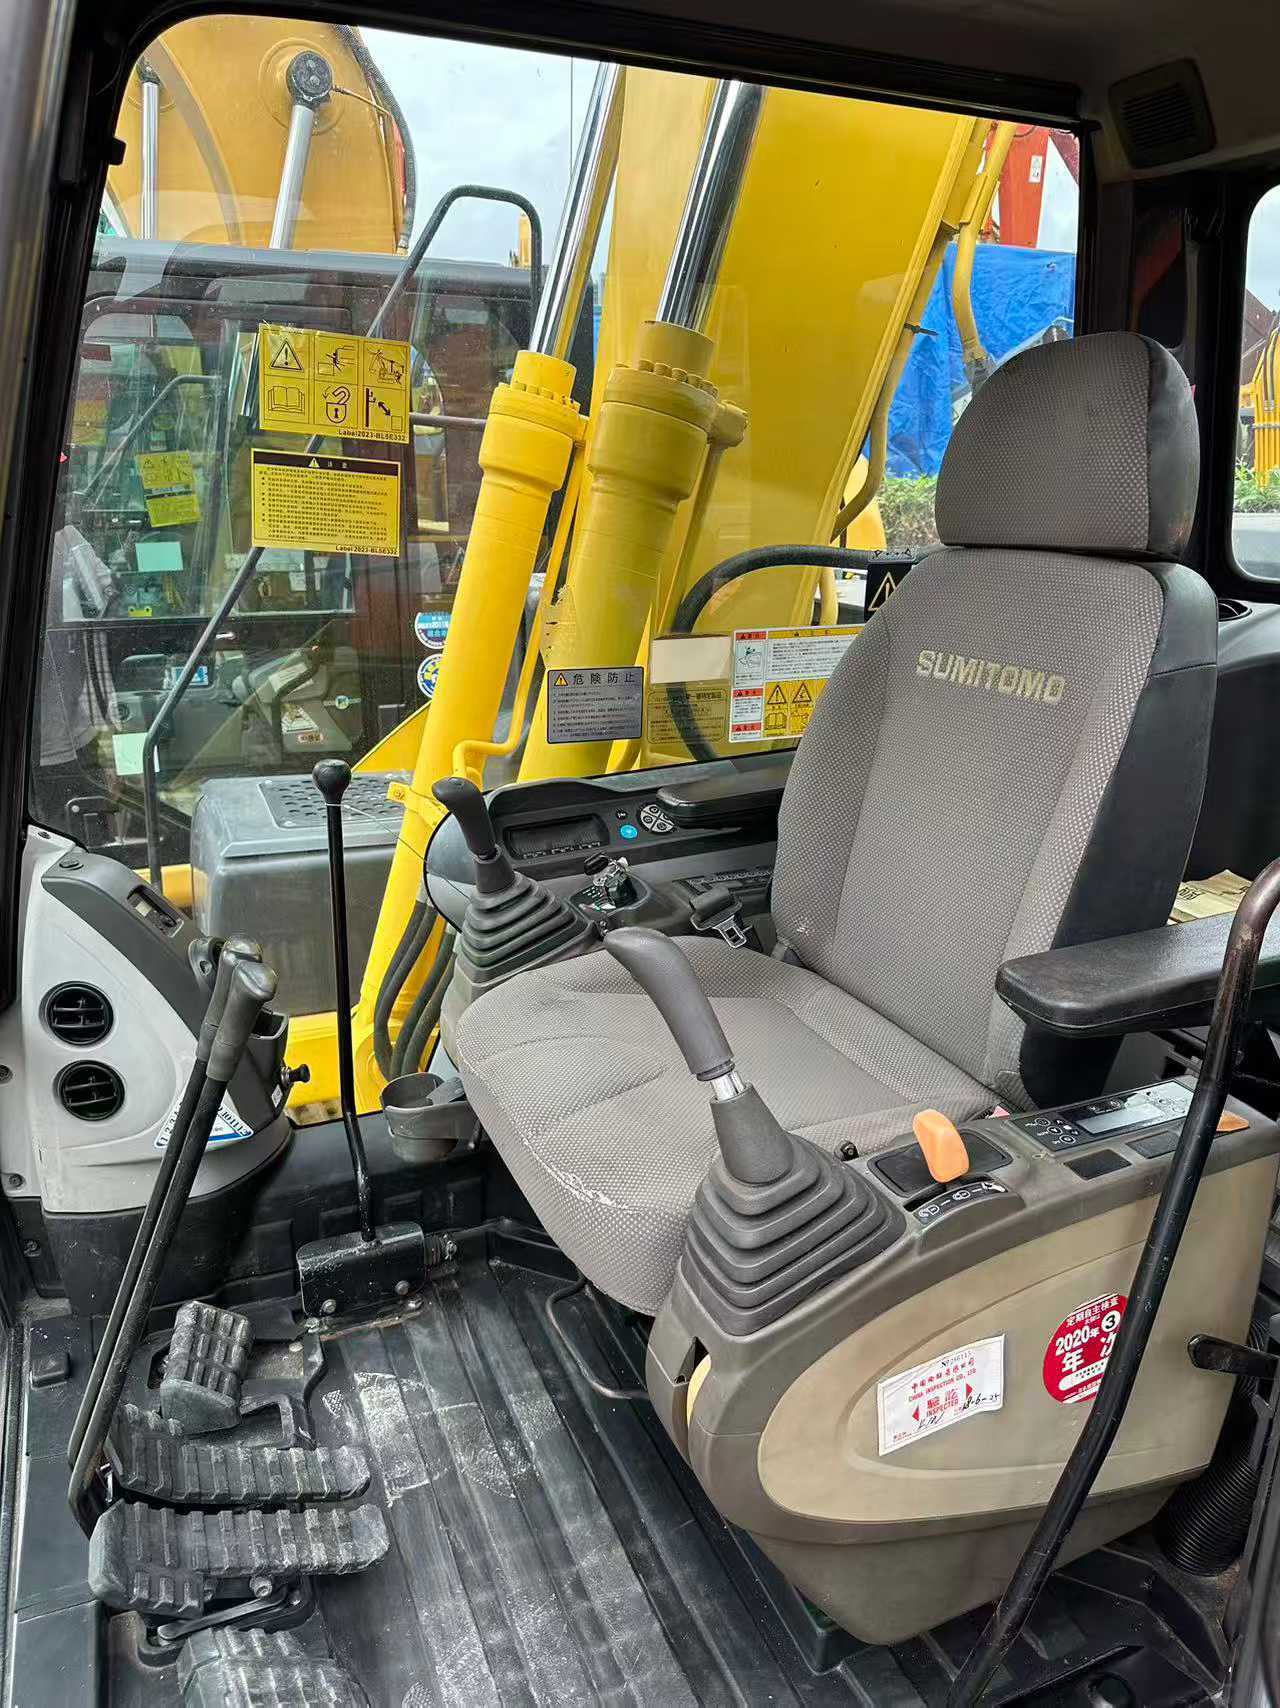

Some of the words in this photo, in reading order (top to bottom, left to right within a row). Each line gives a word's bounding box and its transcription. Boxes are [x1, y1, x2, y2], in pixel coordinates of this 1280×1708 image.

[573, 671, 636, 685] 危険防止
[916, 649, 1066, 702] SUMITOMO
[926, 1398, 960, 1418] INSPECTED
